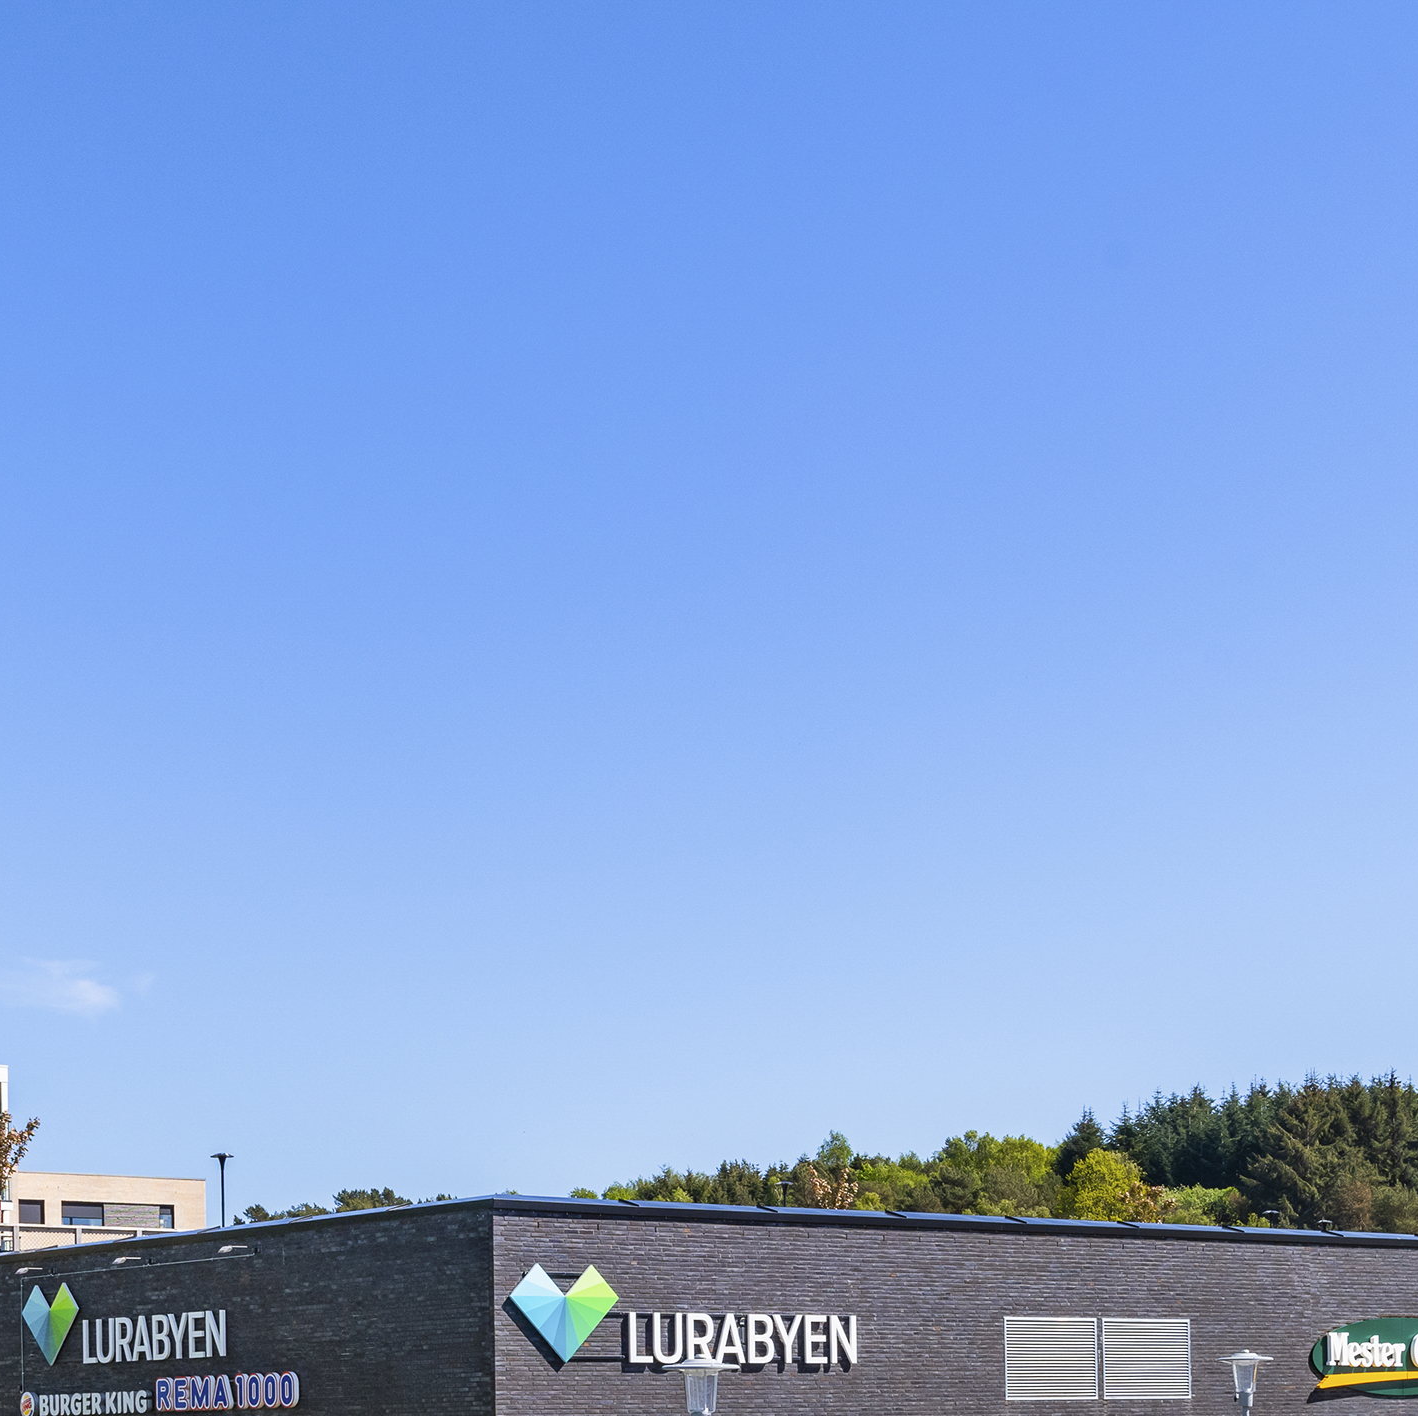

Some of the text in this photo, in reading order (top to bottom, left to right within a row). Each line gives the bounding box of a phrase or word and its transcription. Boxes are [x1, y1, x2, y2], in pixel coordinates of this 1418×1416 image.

[82, 1309, 227, 1364] LURABYEN
[628, 1311, 858, 1365] LURABYEN
[1327, 1331, 1406, 1368] Mester
[38, 1389, 148, 1416] BURGER KING
[155, 1370, 300, 1412] REMA 1000
